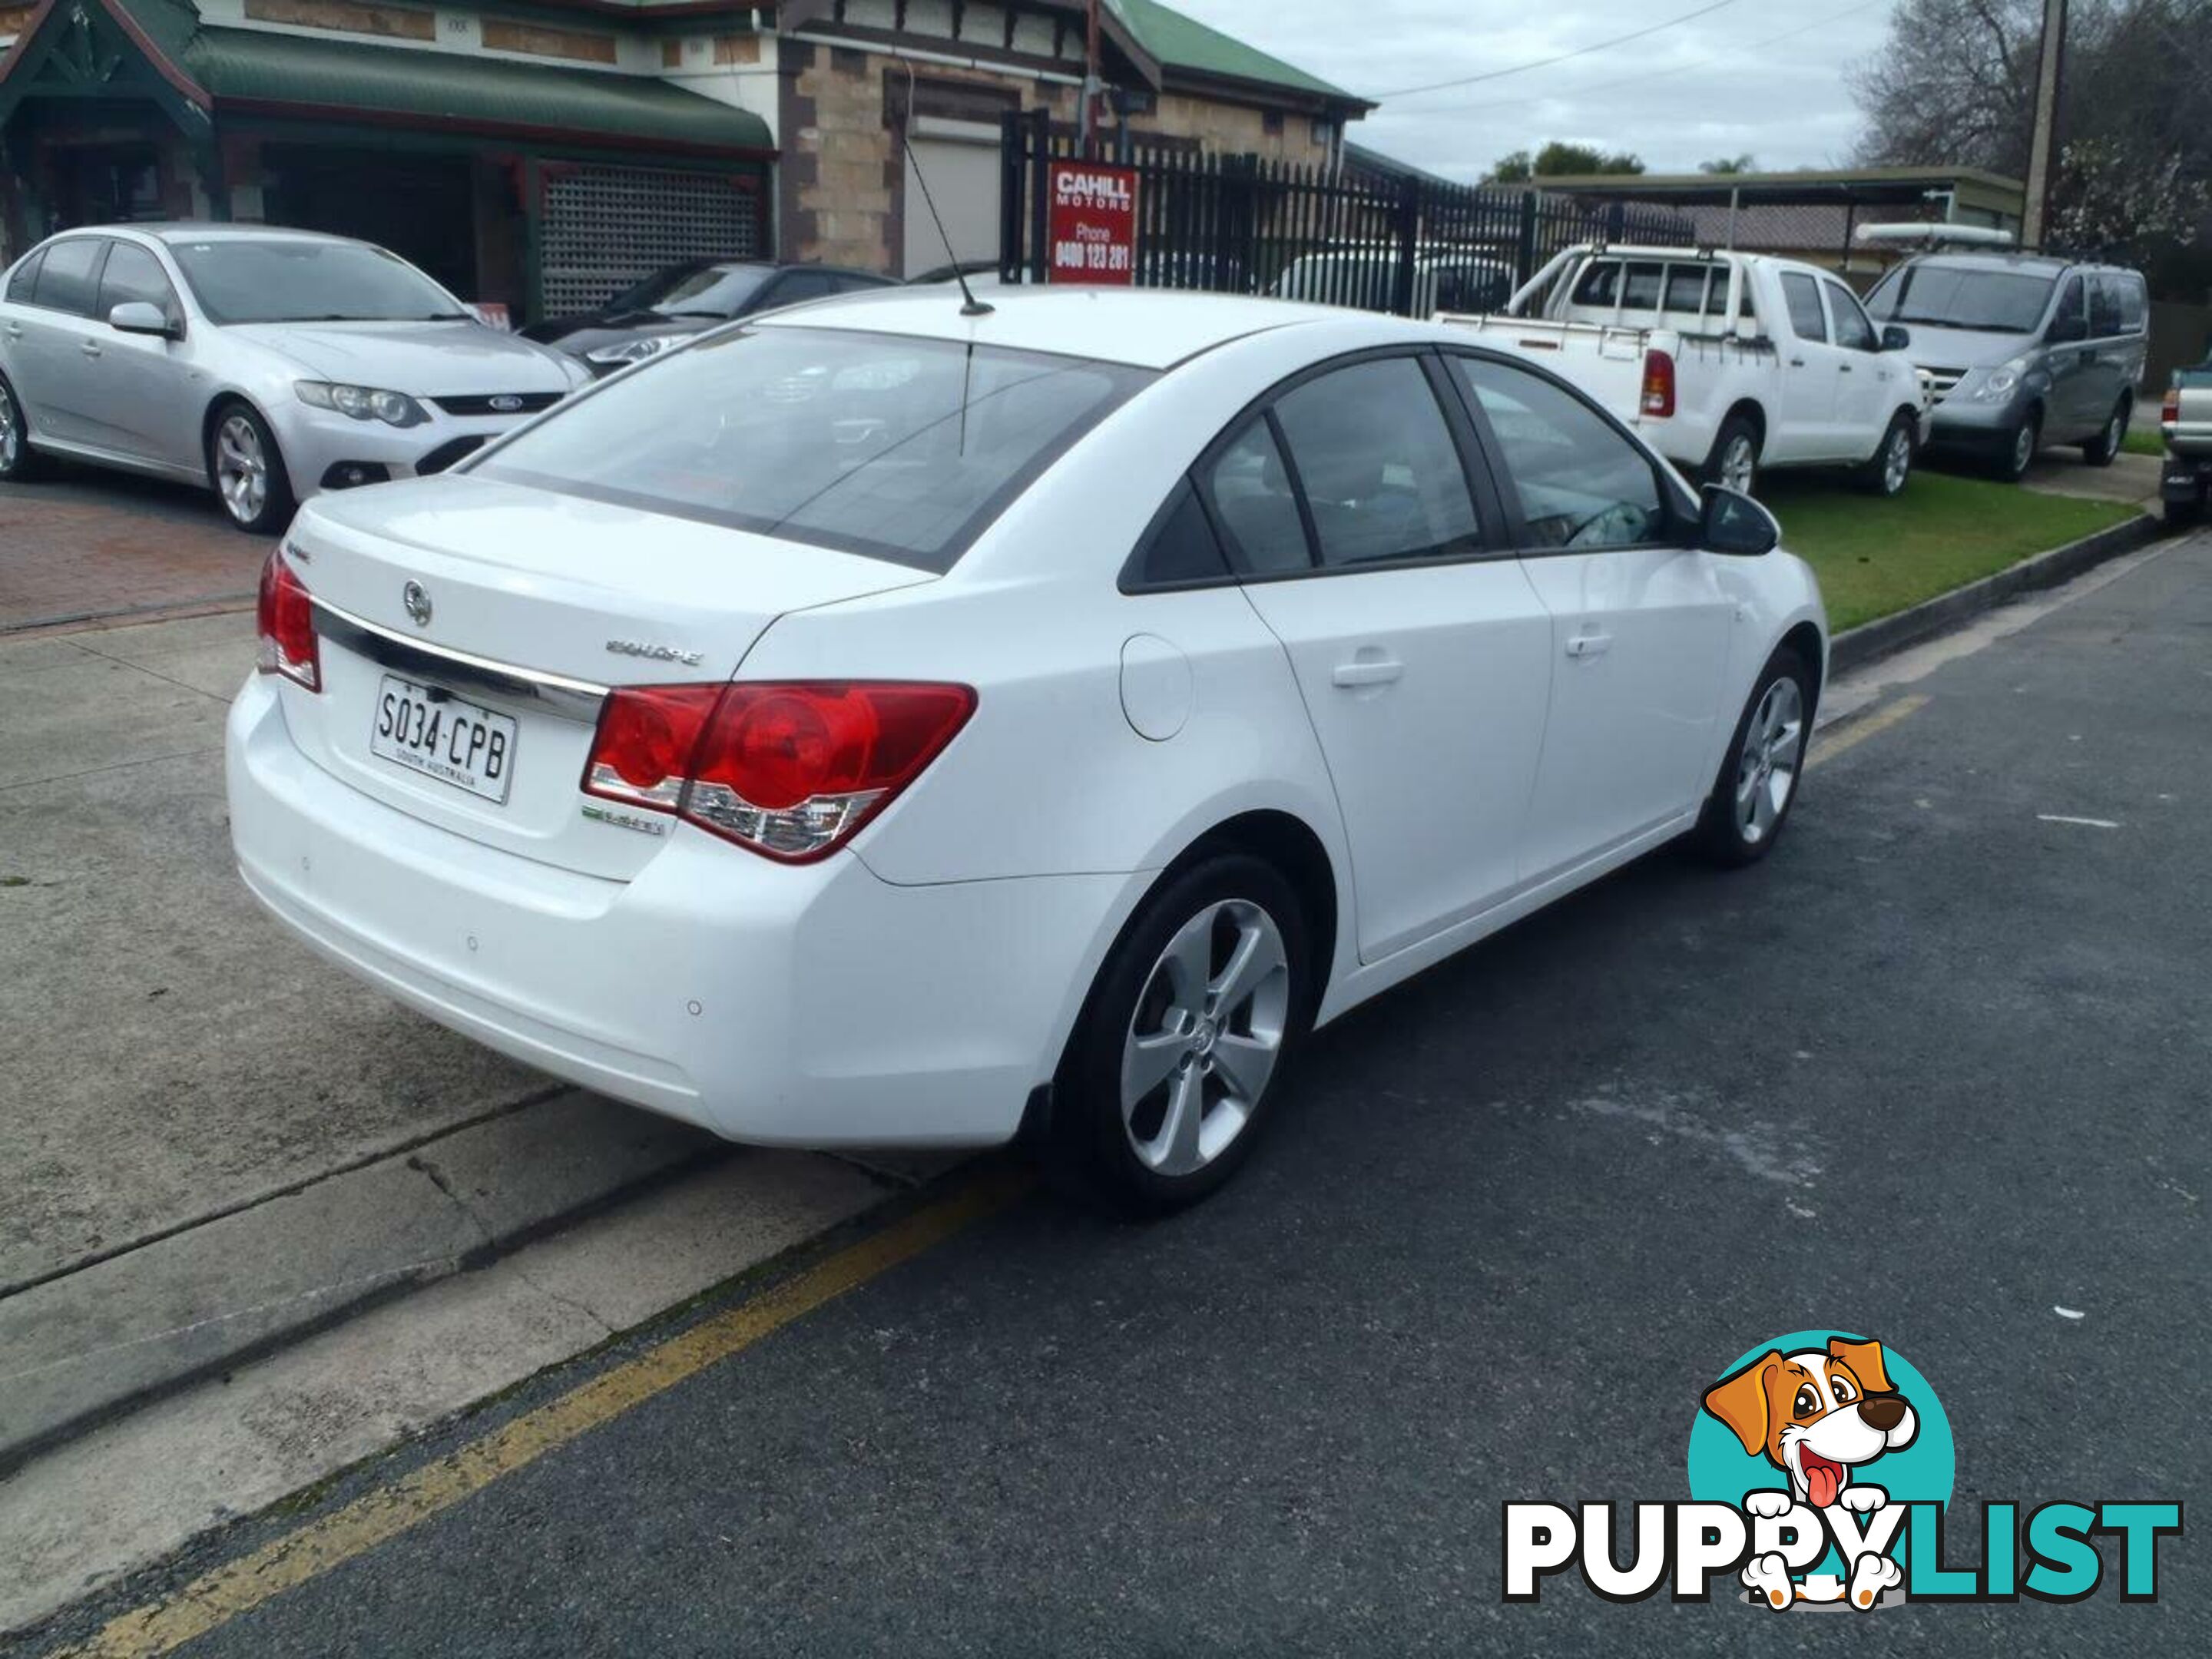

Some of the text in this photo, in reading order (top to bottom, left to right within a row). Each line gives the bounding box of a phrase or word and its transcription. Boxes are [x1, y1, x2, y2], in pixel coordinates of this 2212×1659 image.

[1057, 171, 1130, 200] CAHILL
[1056, 194, 1130, 212] MOTORS
[1076, 222, 1111, 242] Phone
[1087, 243, 1107, 269] 123
